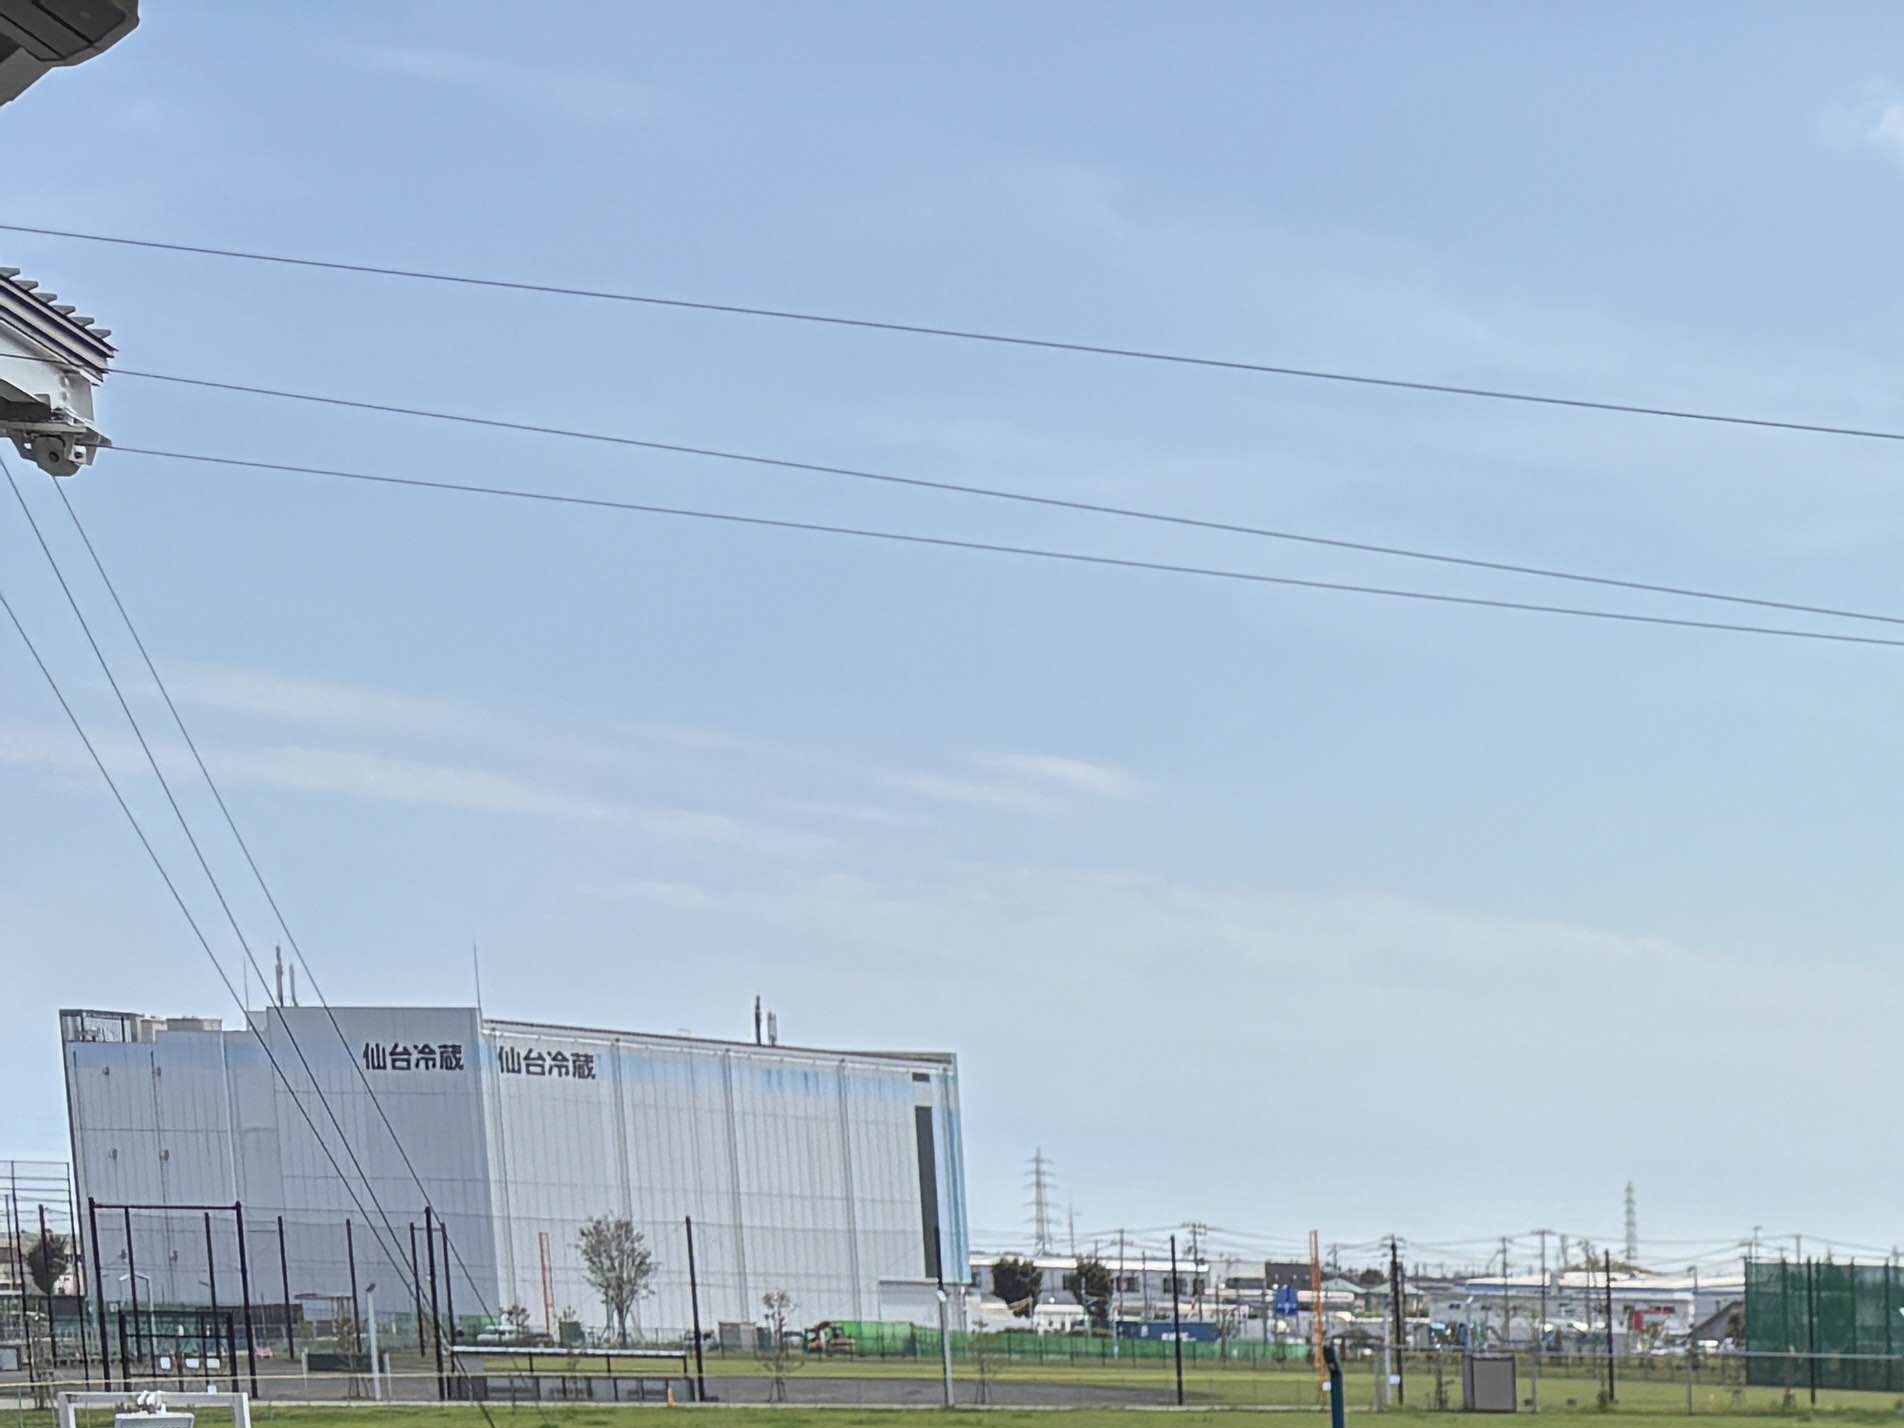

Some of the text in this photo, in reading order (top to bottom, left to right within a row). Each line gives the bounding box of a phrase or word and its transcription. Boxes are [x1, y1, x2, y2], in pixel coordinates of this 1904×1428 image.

[363, 1041, 465, 1071] 仙台冷蔵
[498, 1045, 596, 1080] 仙台冷蔵
